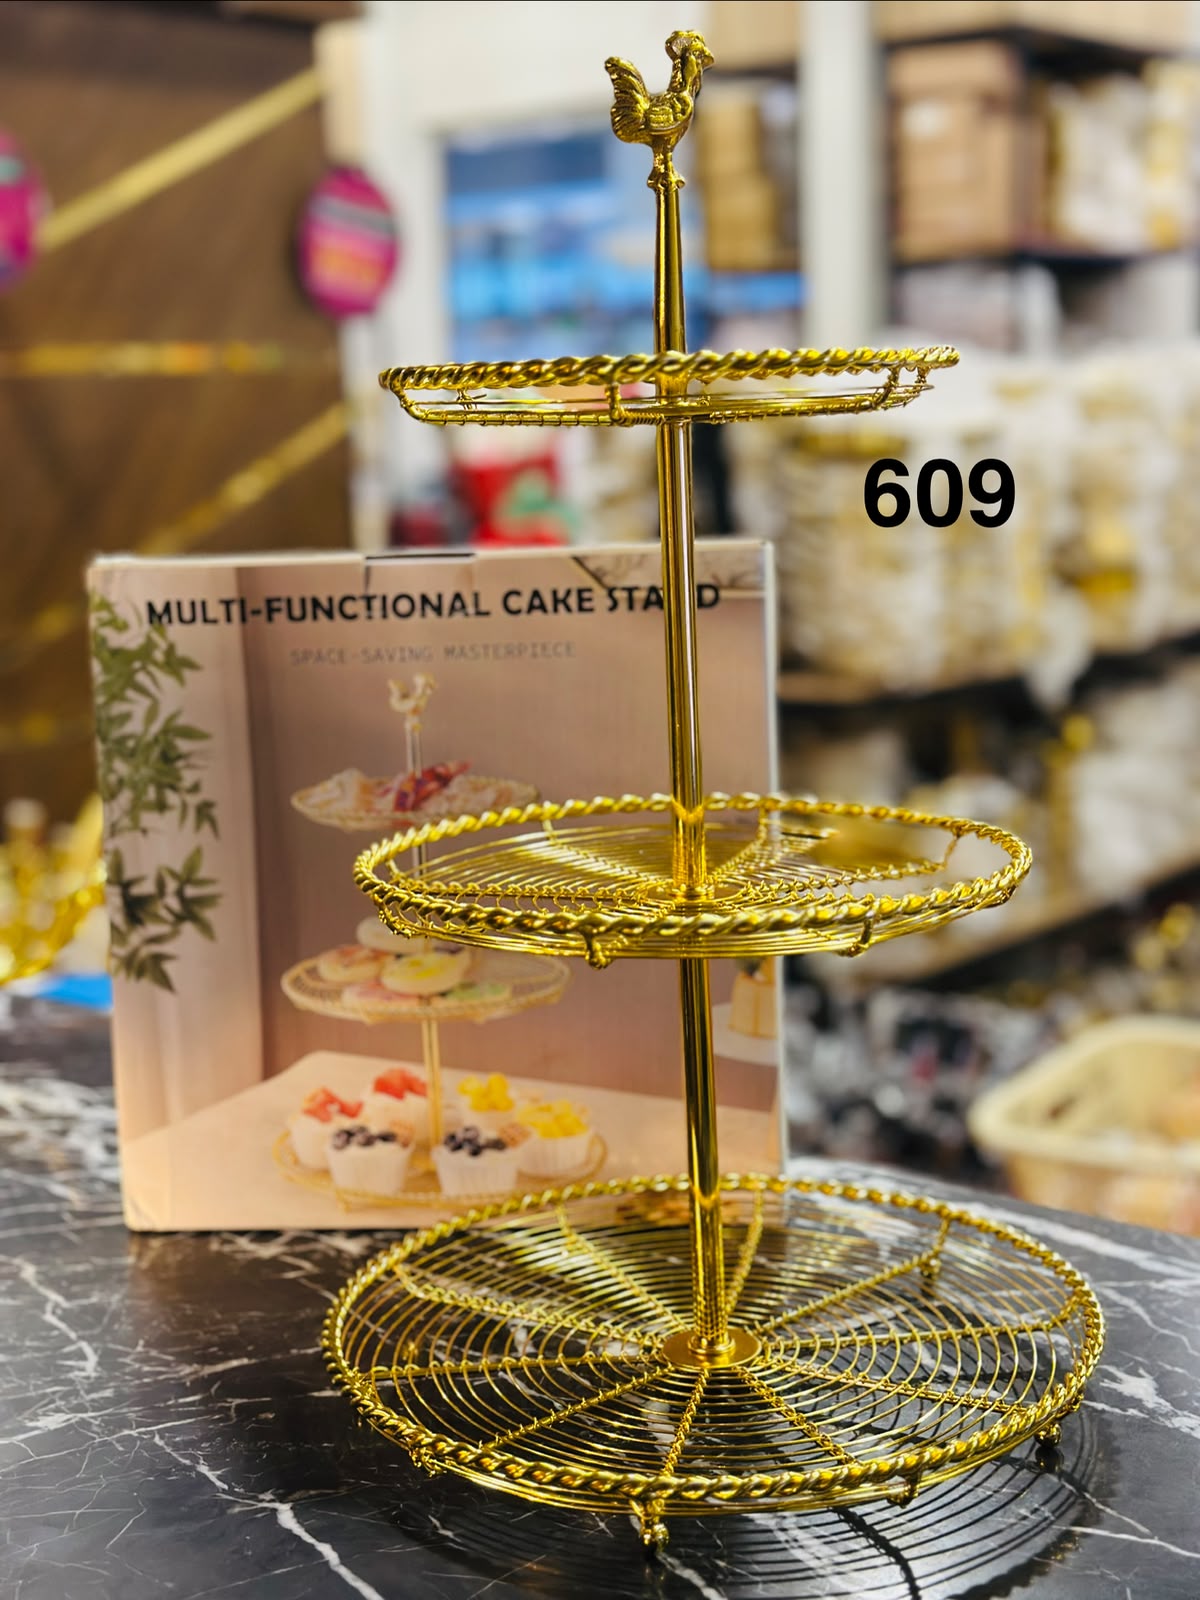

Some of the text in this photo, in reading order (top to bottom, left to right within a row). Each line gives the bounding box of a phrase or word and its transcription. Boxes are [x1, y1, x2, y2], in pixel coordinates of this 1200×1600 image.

[146, 584, 721, 626] MULTI-FUNCTIONAL CAKE STAD
[443, 641, 576, 662] MASTERPIECE
